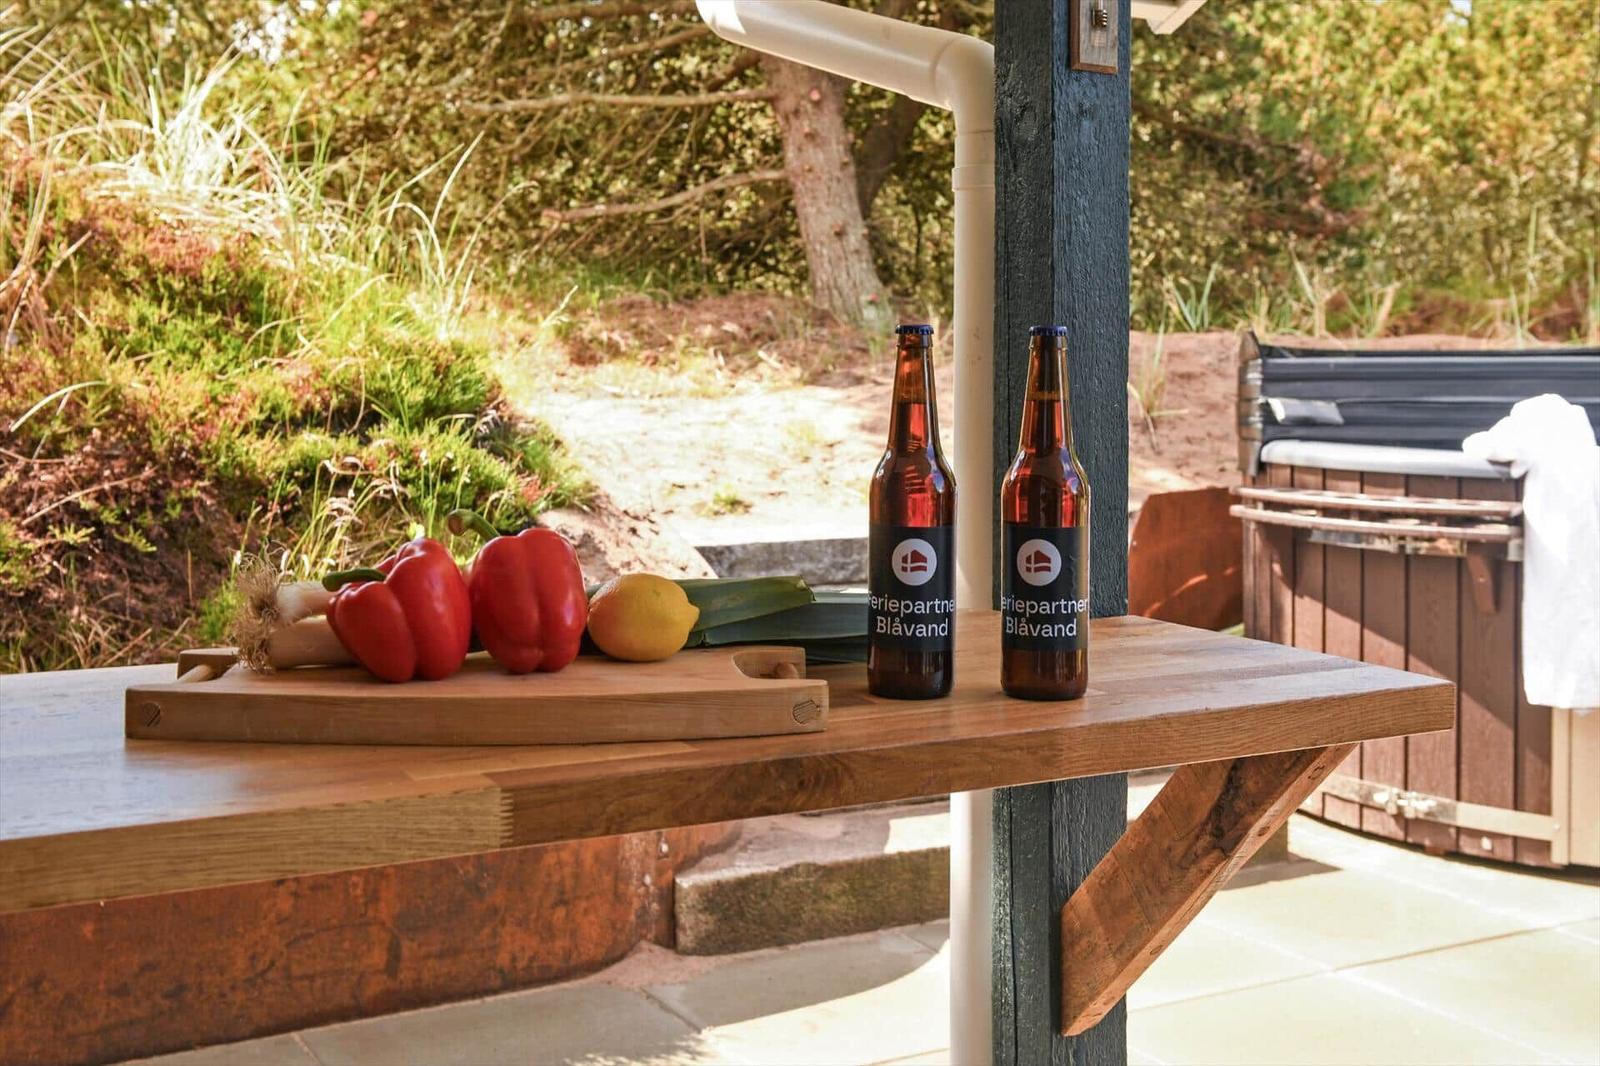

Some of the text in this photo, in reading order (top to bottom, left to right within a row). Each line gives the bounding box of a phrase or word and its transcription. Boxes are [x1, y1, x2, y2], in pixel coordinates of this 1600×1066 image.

[868, 592, 956, 617] eriepartne
[876, 616, 948, 637] Blåvand
[1006, 616, 1077, 637] Blåvand
